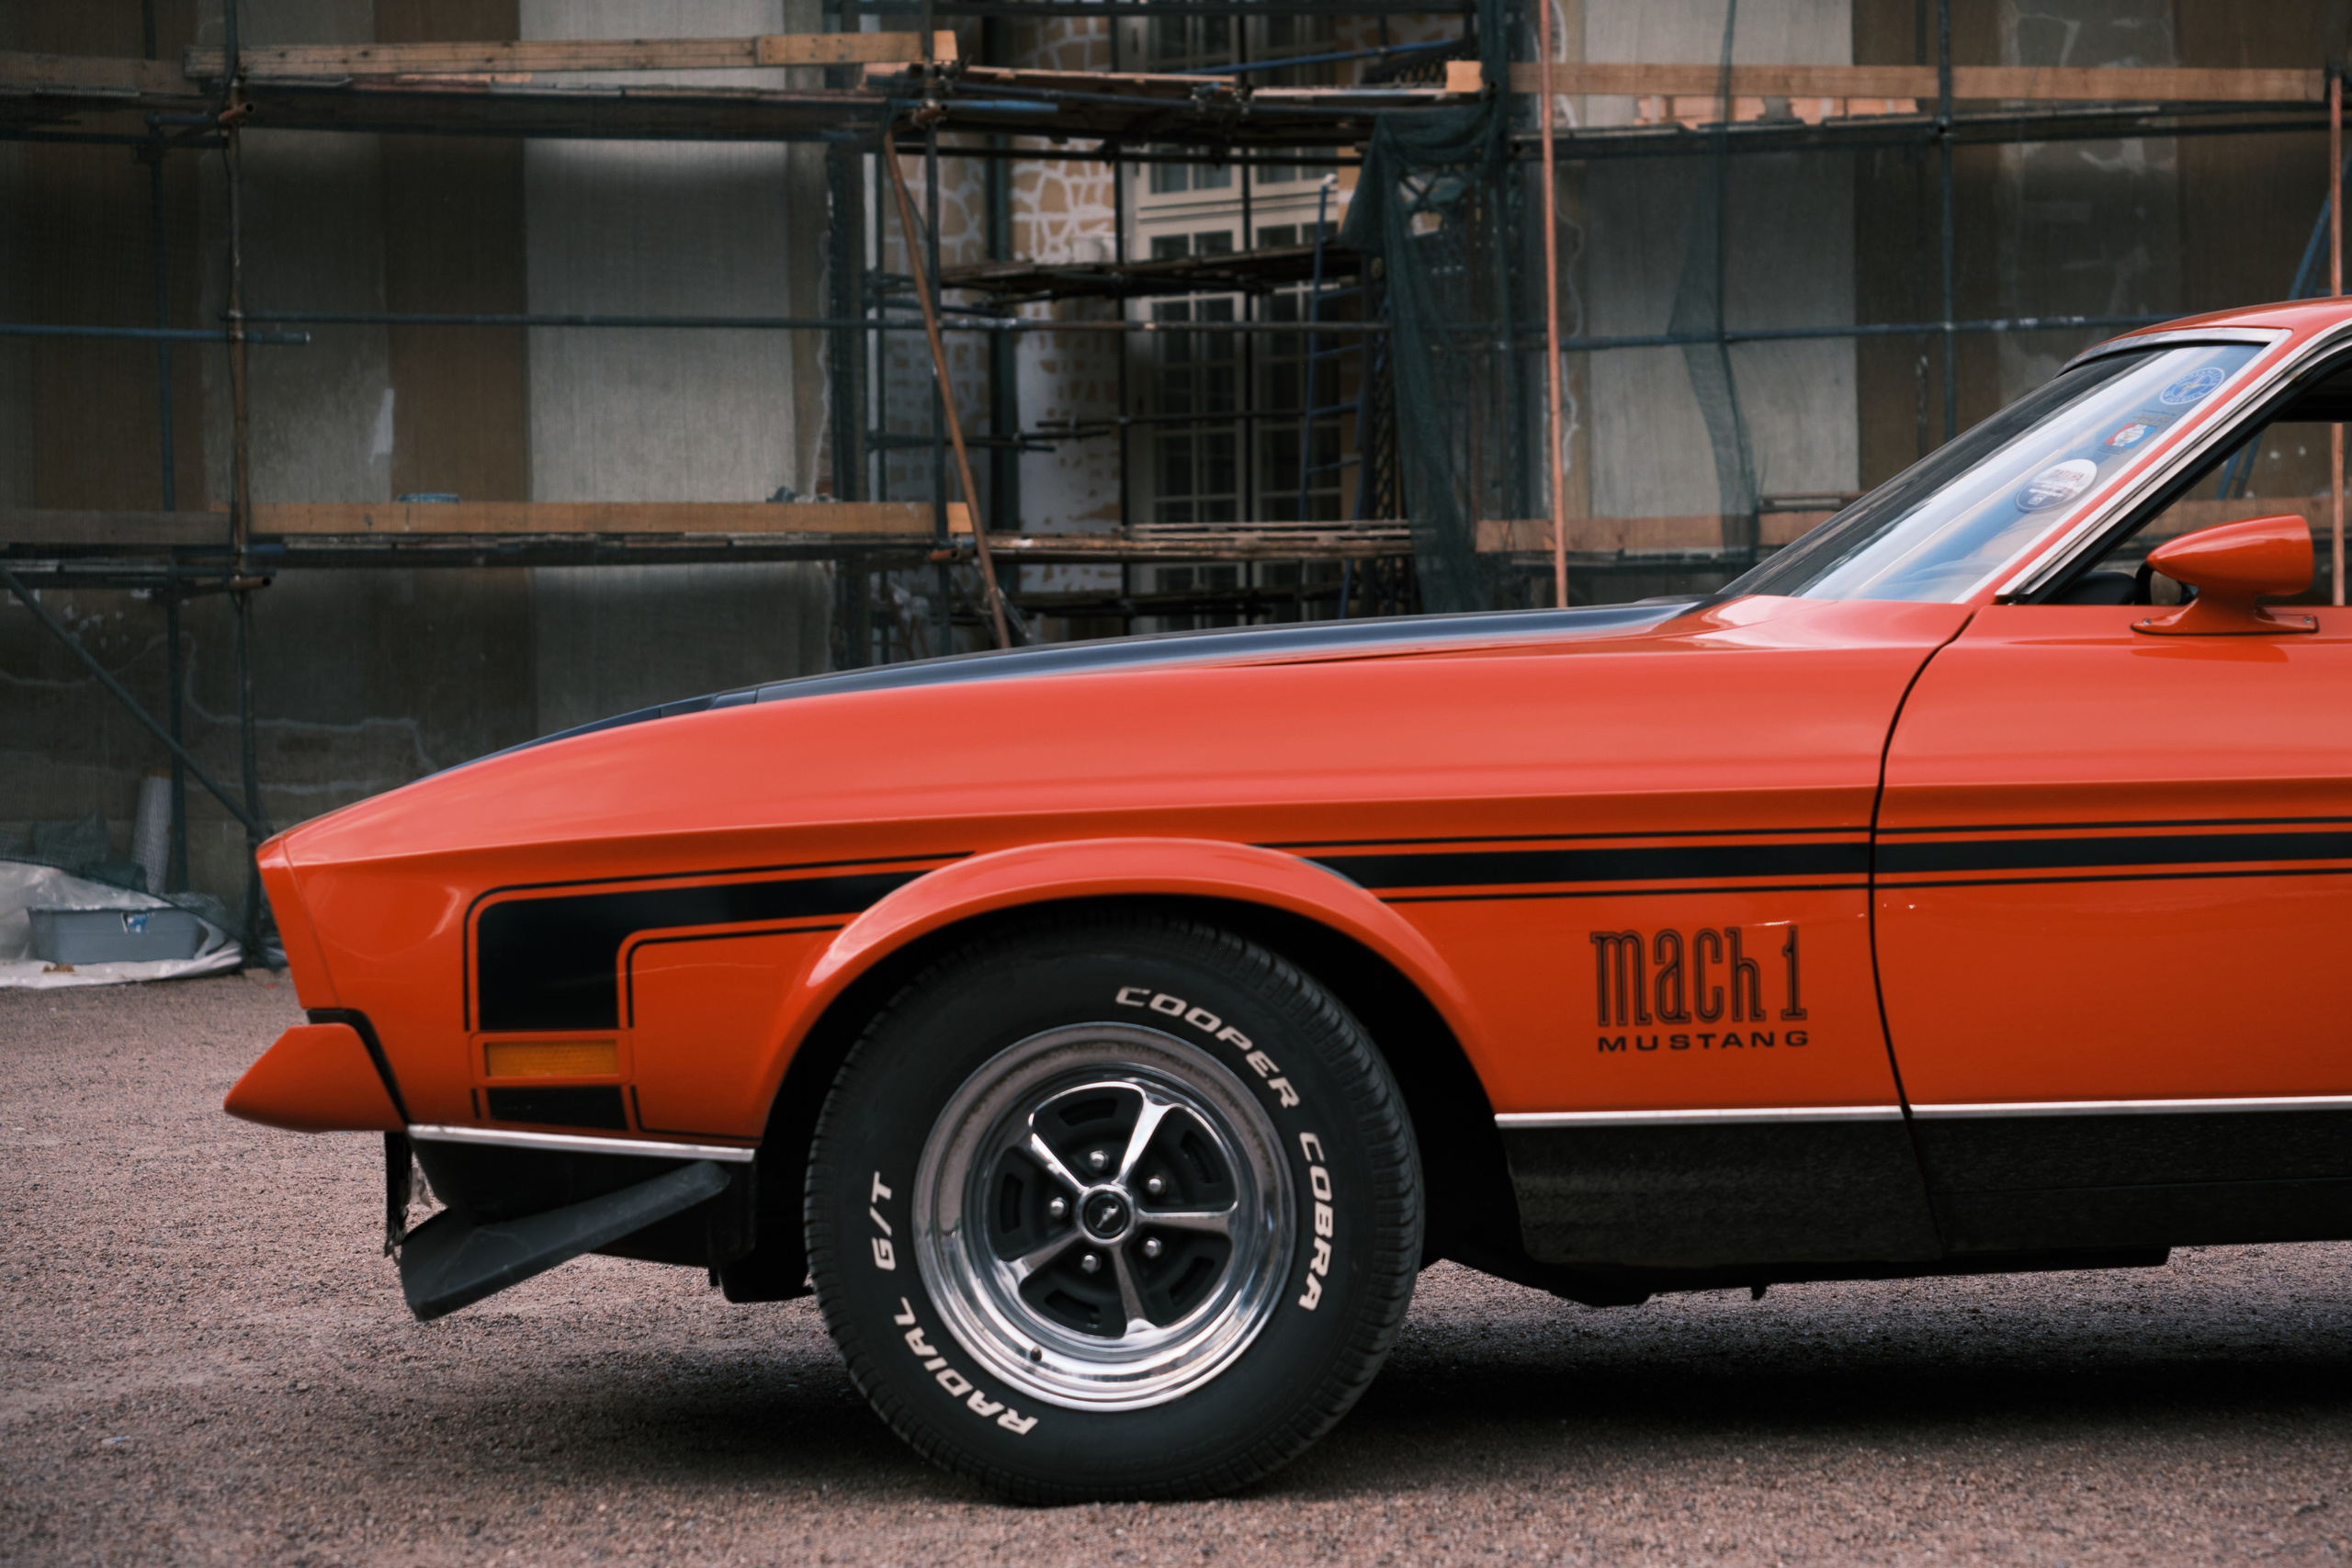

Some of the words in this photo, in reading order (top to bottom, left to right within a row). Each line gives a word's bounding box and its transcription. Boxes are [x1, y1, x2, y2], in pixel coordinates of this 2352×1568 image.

[1781, 924, 1807, 1021] 1
[1598, 1031, 1808, 1053] MUSTANG
[1115, 986, 1300, 1109] COOPER
[1298, 1131, 1334, 1311] COBRA
[870, 1170, 896, 1271] G/T
[893, 1296, 1039, 1436] RADIAL
